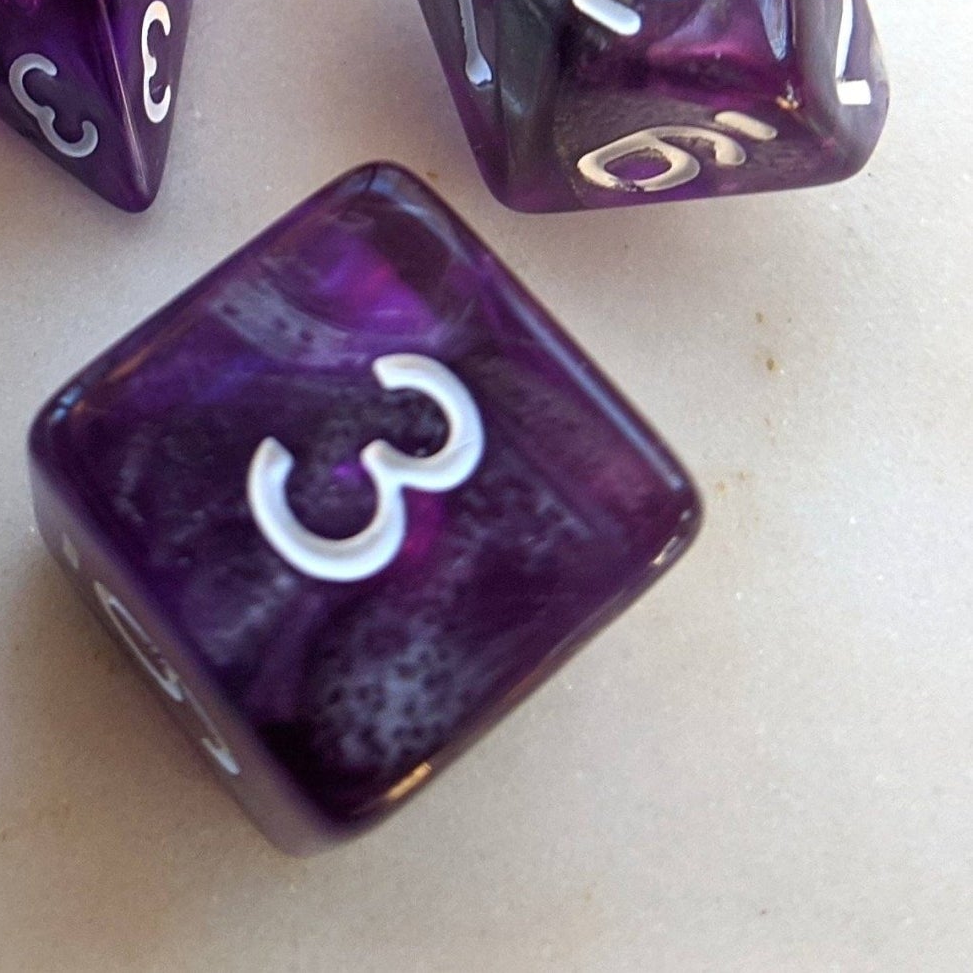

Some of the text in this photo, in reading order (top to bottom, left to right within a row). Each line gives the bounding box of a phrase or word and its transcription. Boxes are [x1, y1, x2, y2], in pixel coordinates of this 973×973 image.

[9, 52, 98, 158] 3
[140, 0, 172, 124] 3
[247, 353, 485, 582] 3
